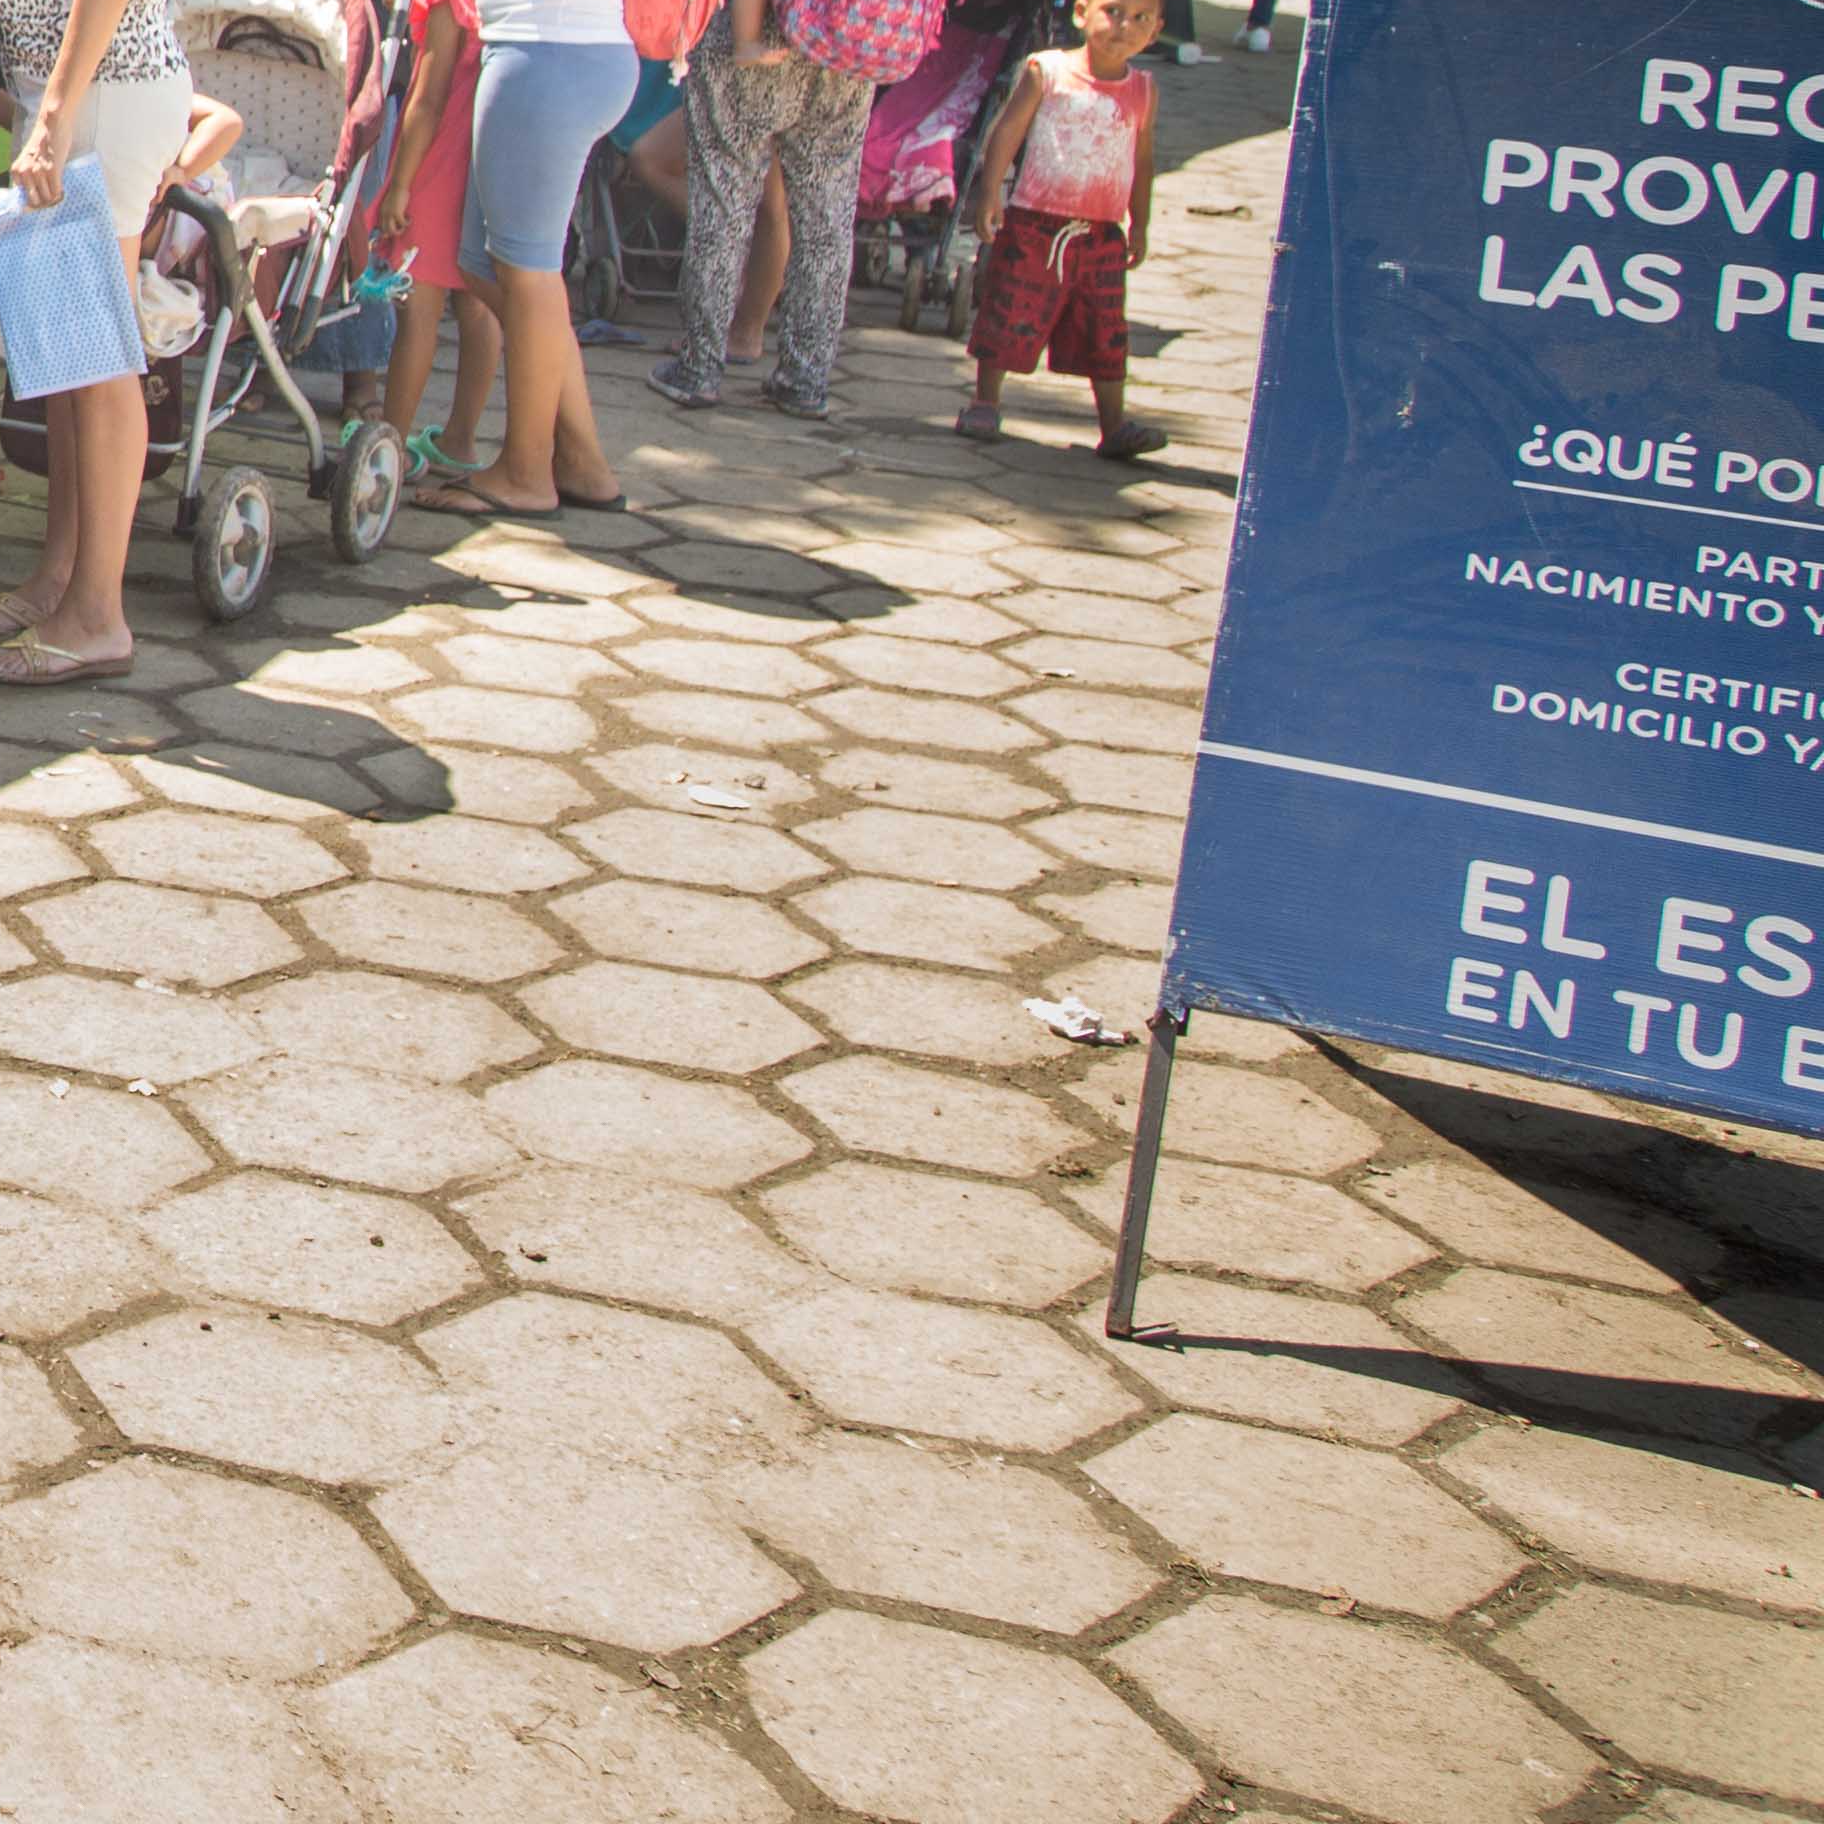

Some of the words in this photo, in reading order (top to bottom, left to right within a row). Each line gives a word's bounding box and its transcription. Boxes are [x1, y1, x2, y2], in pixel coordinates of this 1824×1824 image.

[1478, 234, 1683, 325] LAS
[1518, 423, 1695, 488] ¿QUÉ
[1465, 552, 1786, 630] NACIMIENTO
[1492, 683, 1766, 756] DOMICILIO
[1460, 859, 1606, 960] EL
[1656, 895, 1814, 998] ES
[1446, 956, 1575, 1039] EN
[1613, 988, 1743, 1071] TU
